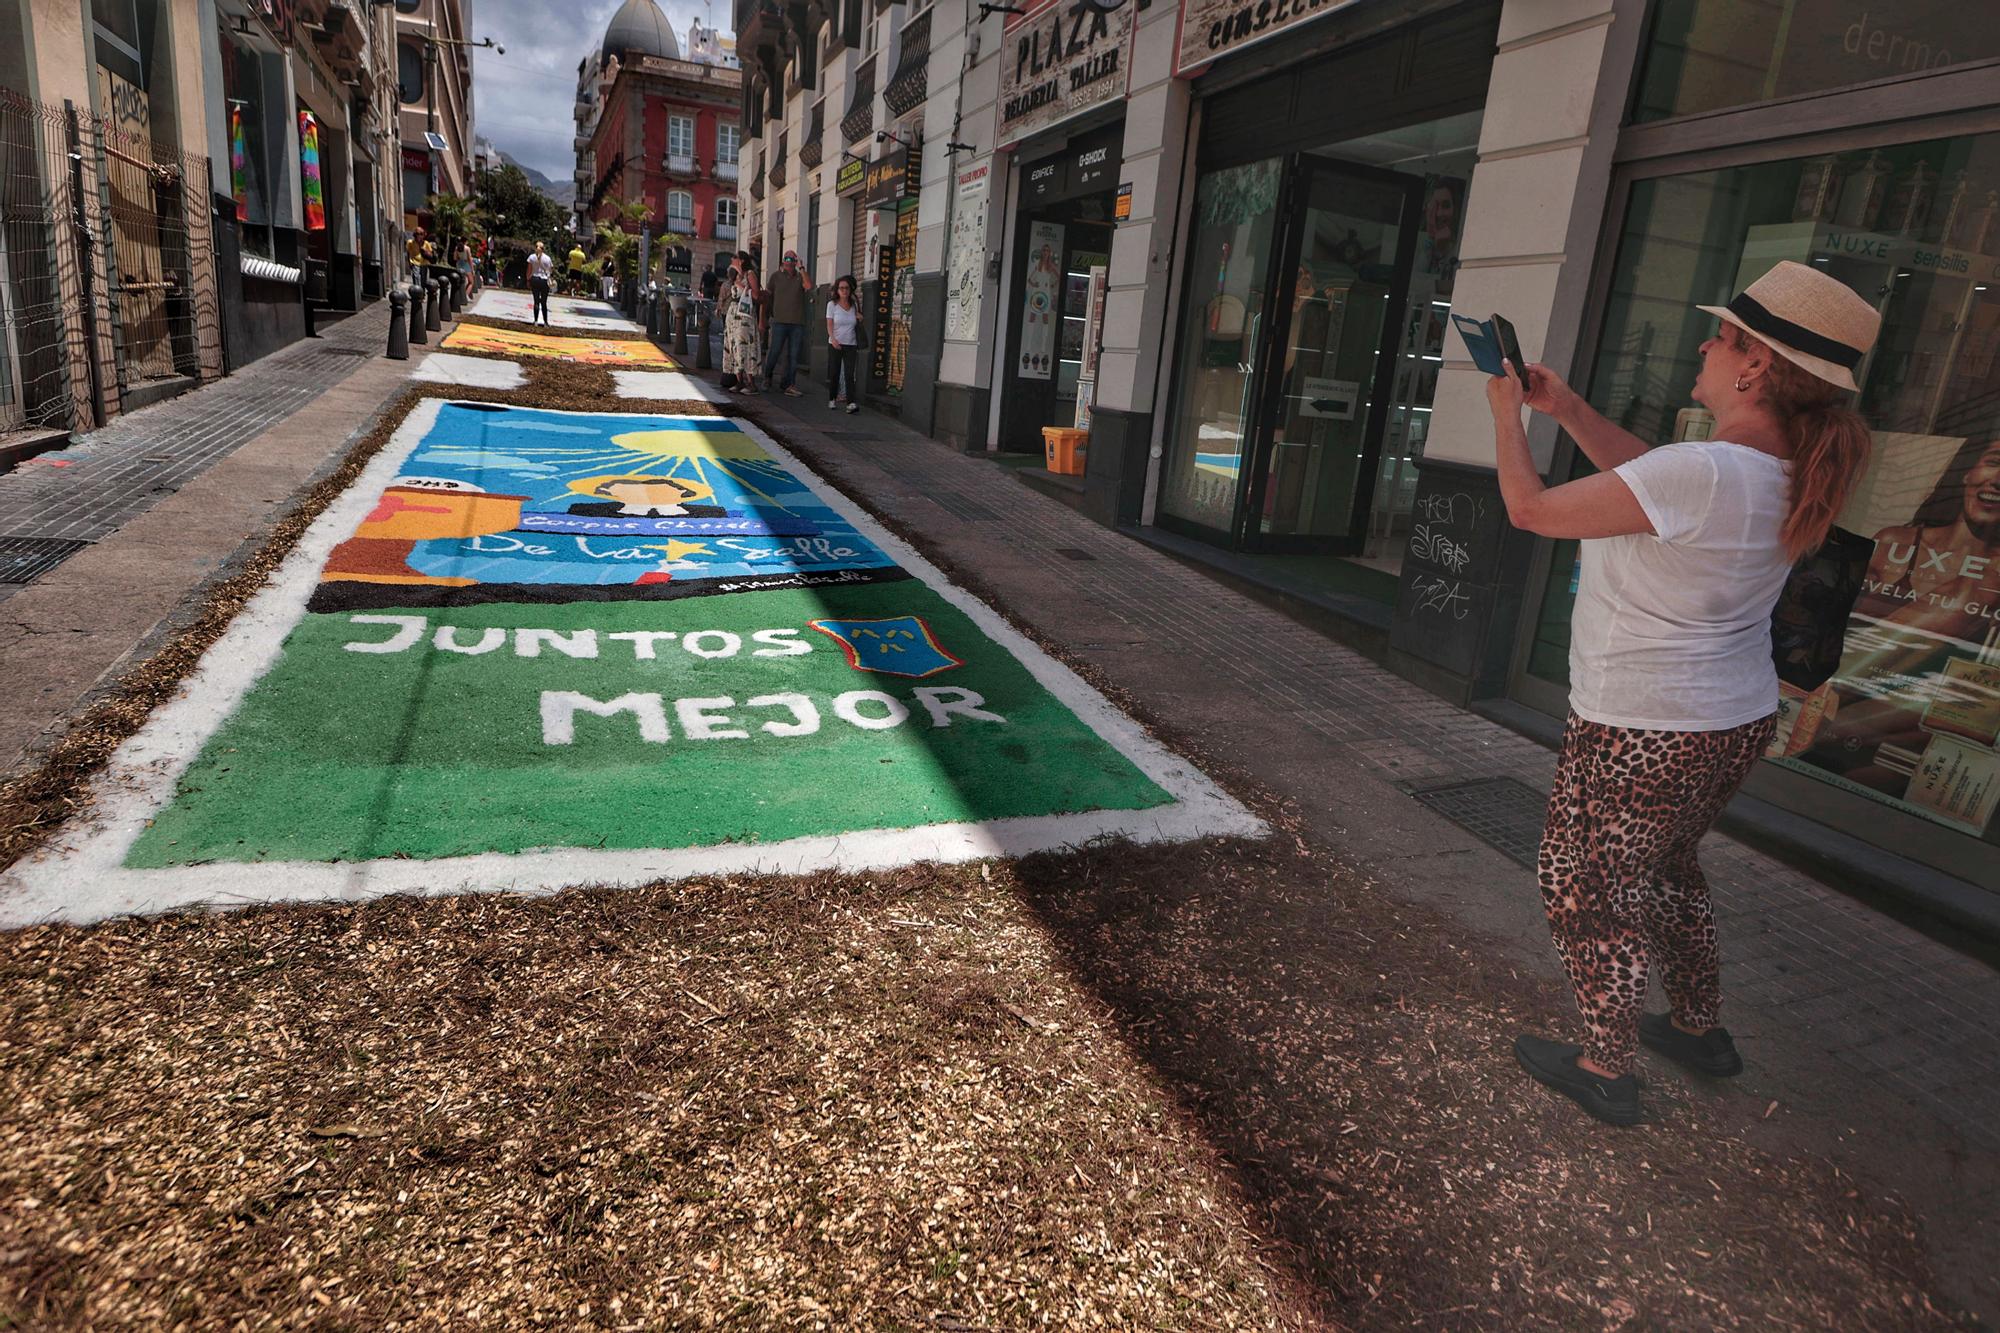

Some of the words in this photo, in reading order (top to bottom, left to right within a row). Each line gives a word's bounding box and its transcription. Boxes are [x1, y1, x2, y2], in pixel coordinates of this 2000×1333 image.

[1016, 2, 1108, 84] PLAZA
[1070, 47, 1119, 92] TALLER
[1097, 80, 1114, 98] 1994
[1079, 147, 1107, 167] G-SHOCK
[1031, 164, 1054, 181] EDIFICE
[1826, 232, 1890, 258] NUXE
[668, 264, 689, 273] ZARA
[1913, 249, 1970, 273] sensilis
[879, 250, 891, 314] SERVICIO
[874, 322, 886, 377] TECNICO
[460, 533, 557, 556] De
[574, 536, 656, 560] La
[715, 537, 861, 561] Salle
[1929, 592, 1954, 609] TU
[343, 615, 814, 660] JUNTOS
[540, 685, 1007, 746] MEJOR
[1926, 755, 1947, 791] NUXE
